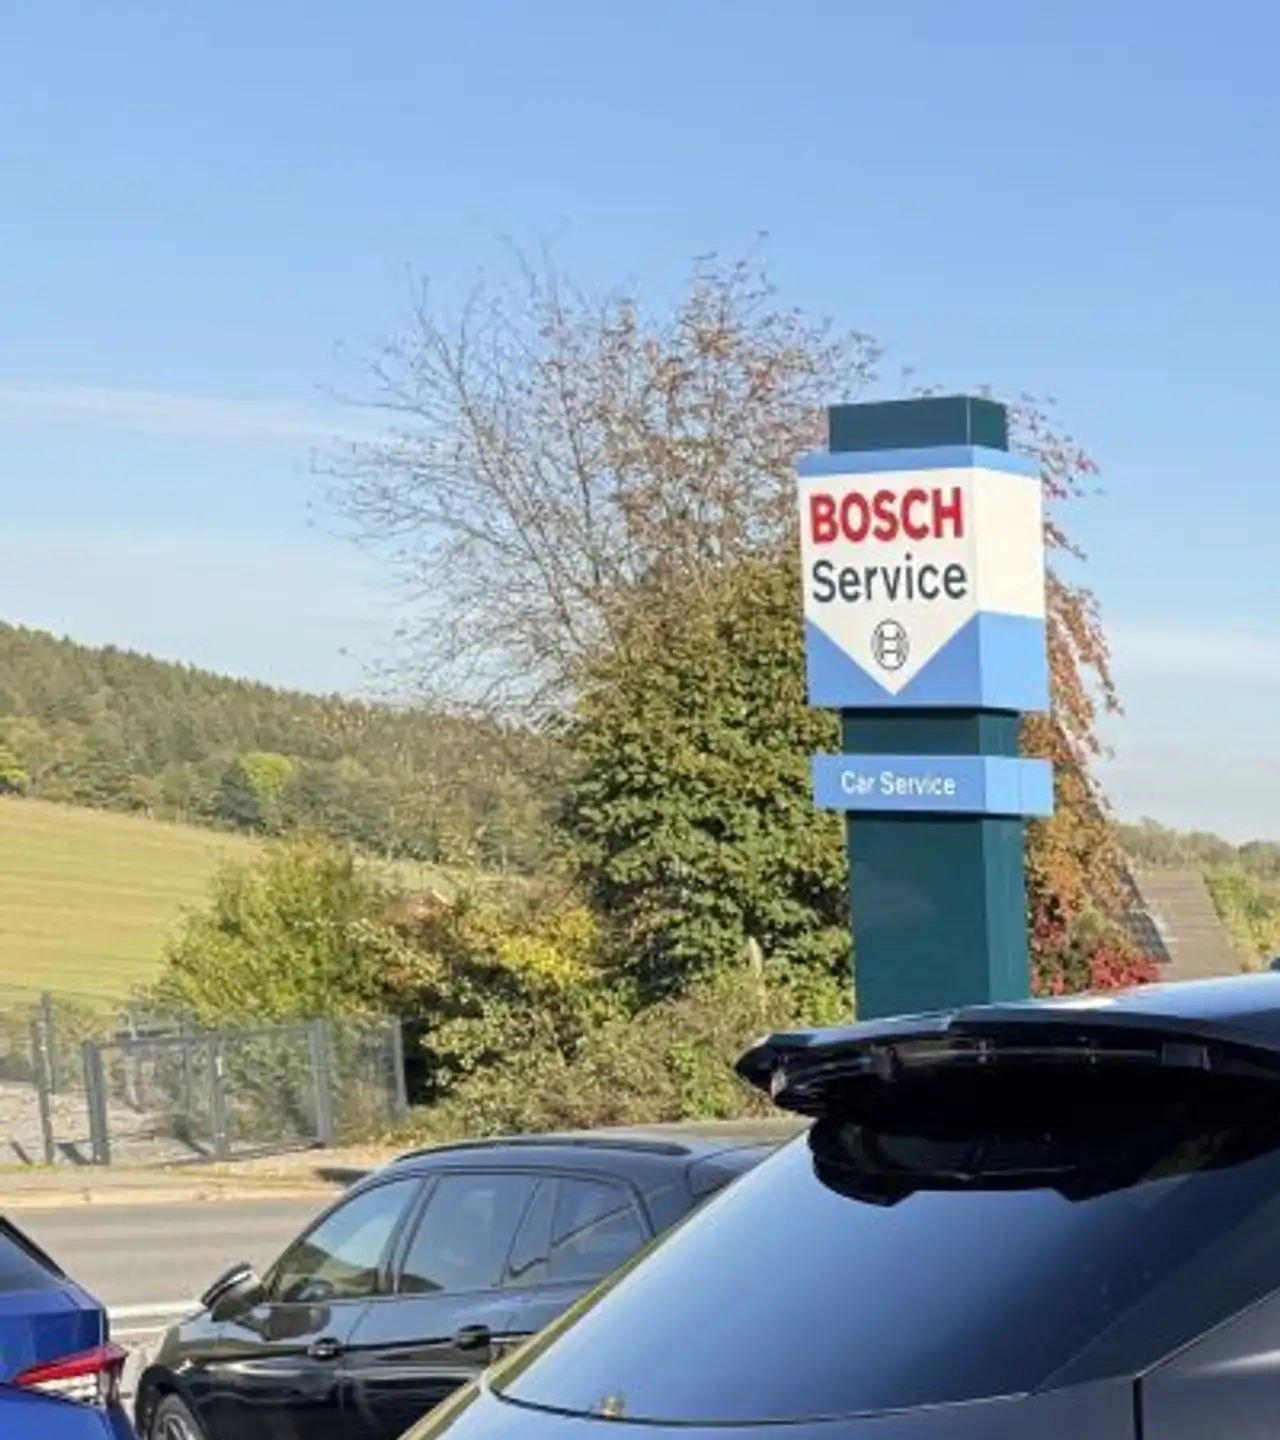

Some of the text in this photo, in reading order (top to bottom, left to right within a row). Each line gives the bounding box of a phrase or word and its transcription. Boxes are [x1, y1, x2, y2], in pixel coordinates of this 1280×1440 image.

[808, 486, 965, 544] BOSCH
[811, 553, 968, 602] Service
[840, 770, 956, 796] Car Service
